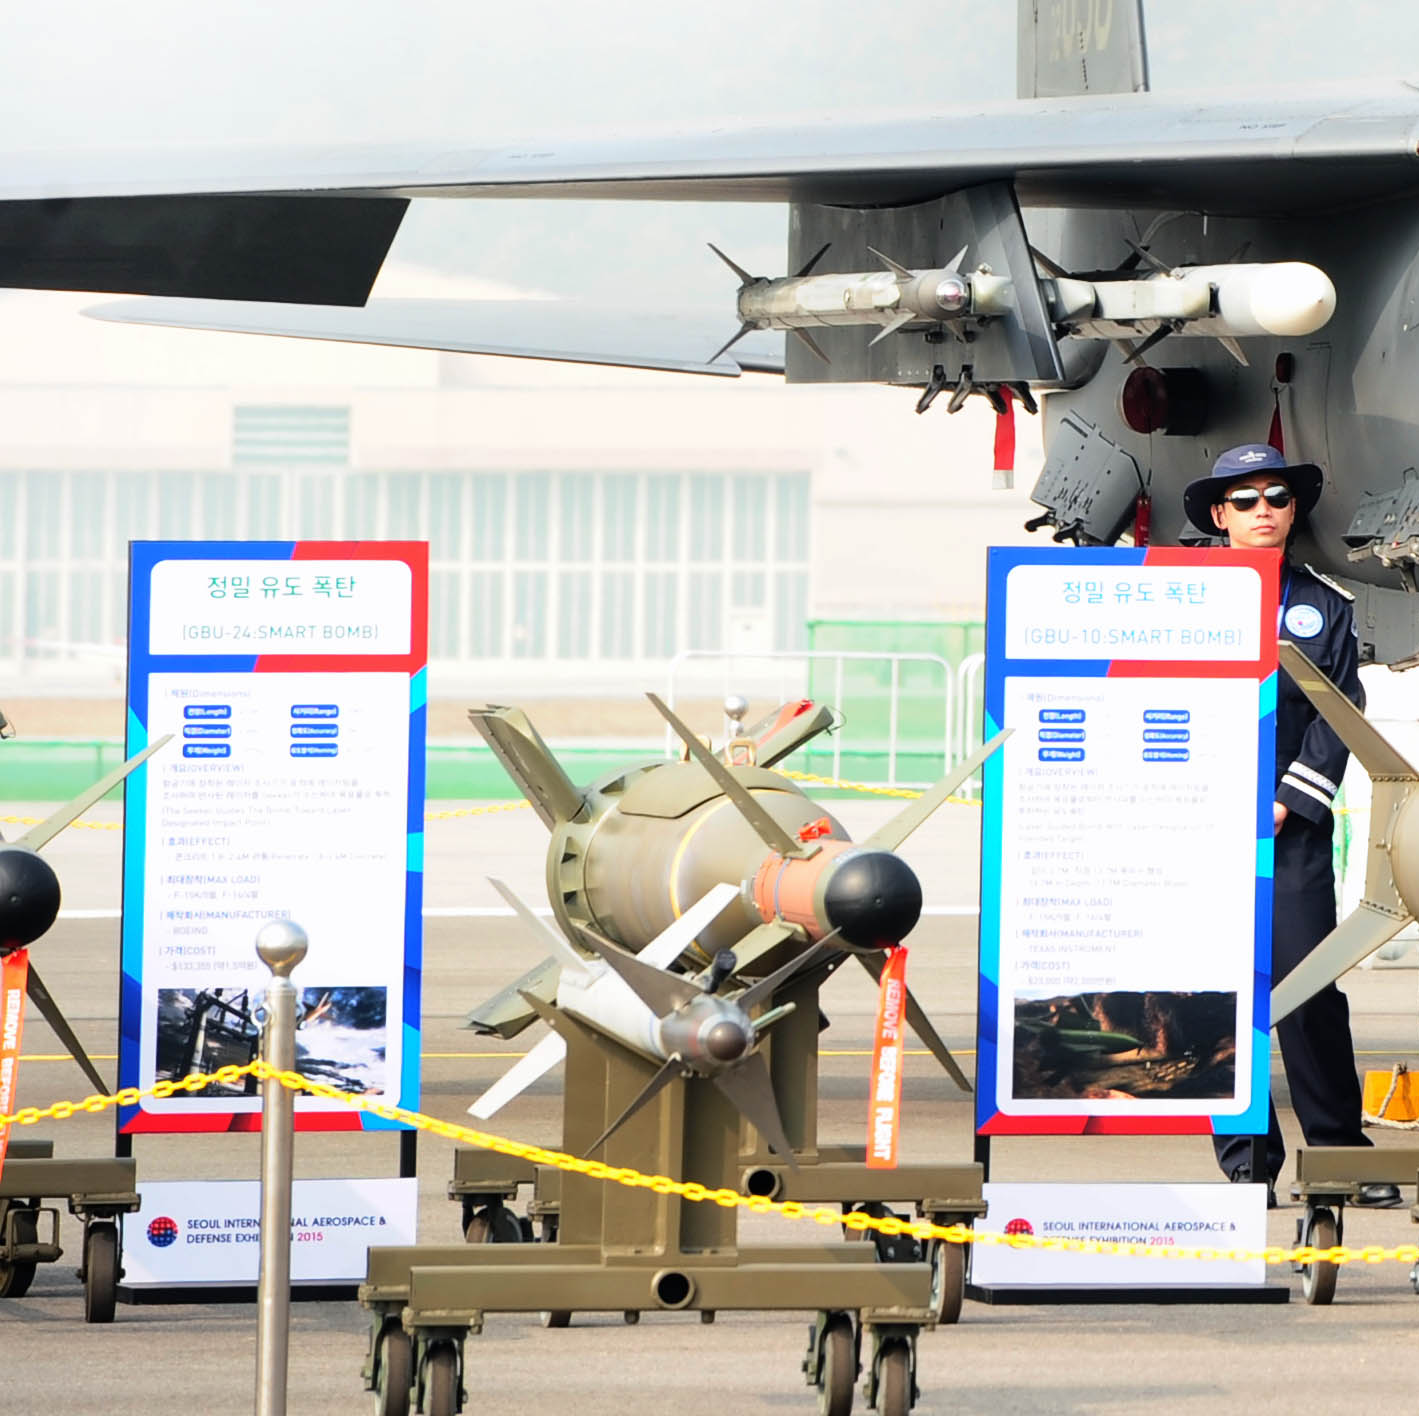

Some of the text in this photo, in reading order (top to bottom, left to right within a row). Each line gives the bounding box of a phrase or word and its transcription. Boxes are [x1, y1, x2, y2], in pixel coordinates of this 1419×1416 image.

[207, 575, 357, 600] 정밀 유도 폭탄
[1062, 580, 1208, 605] 정밀 유도 폭탄
[323, 624, 379, 640] BOMB)
[1180, 628, 1242, 646] BOMB)
[882, 978, 900, 1040] REMOVE
[3, 989, 21, 1051] REMOVE
[873, 1107, 894, 1161] FLIGHT
[187, 1218, 220, 1229] SEOUL
[312, 1216, 376, 1226] AEROSPACE
[379, 1216, 386, 1225] &
[1043, 1222, 1236, 1231] SEOUL INTERNATIONAL AEROSPACE &
[187, 1233, 232, 1244] DEFENSE
[297, 1232, 323, 1242] 2015
[1150, 1236, 1175, 1246] 2015
